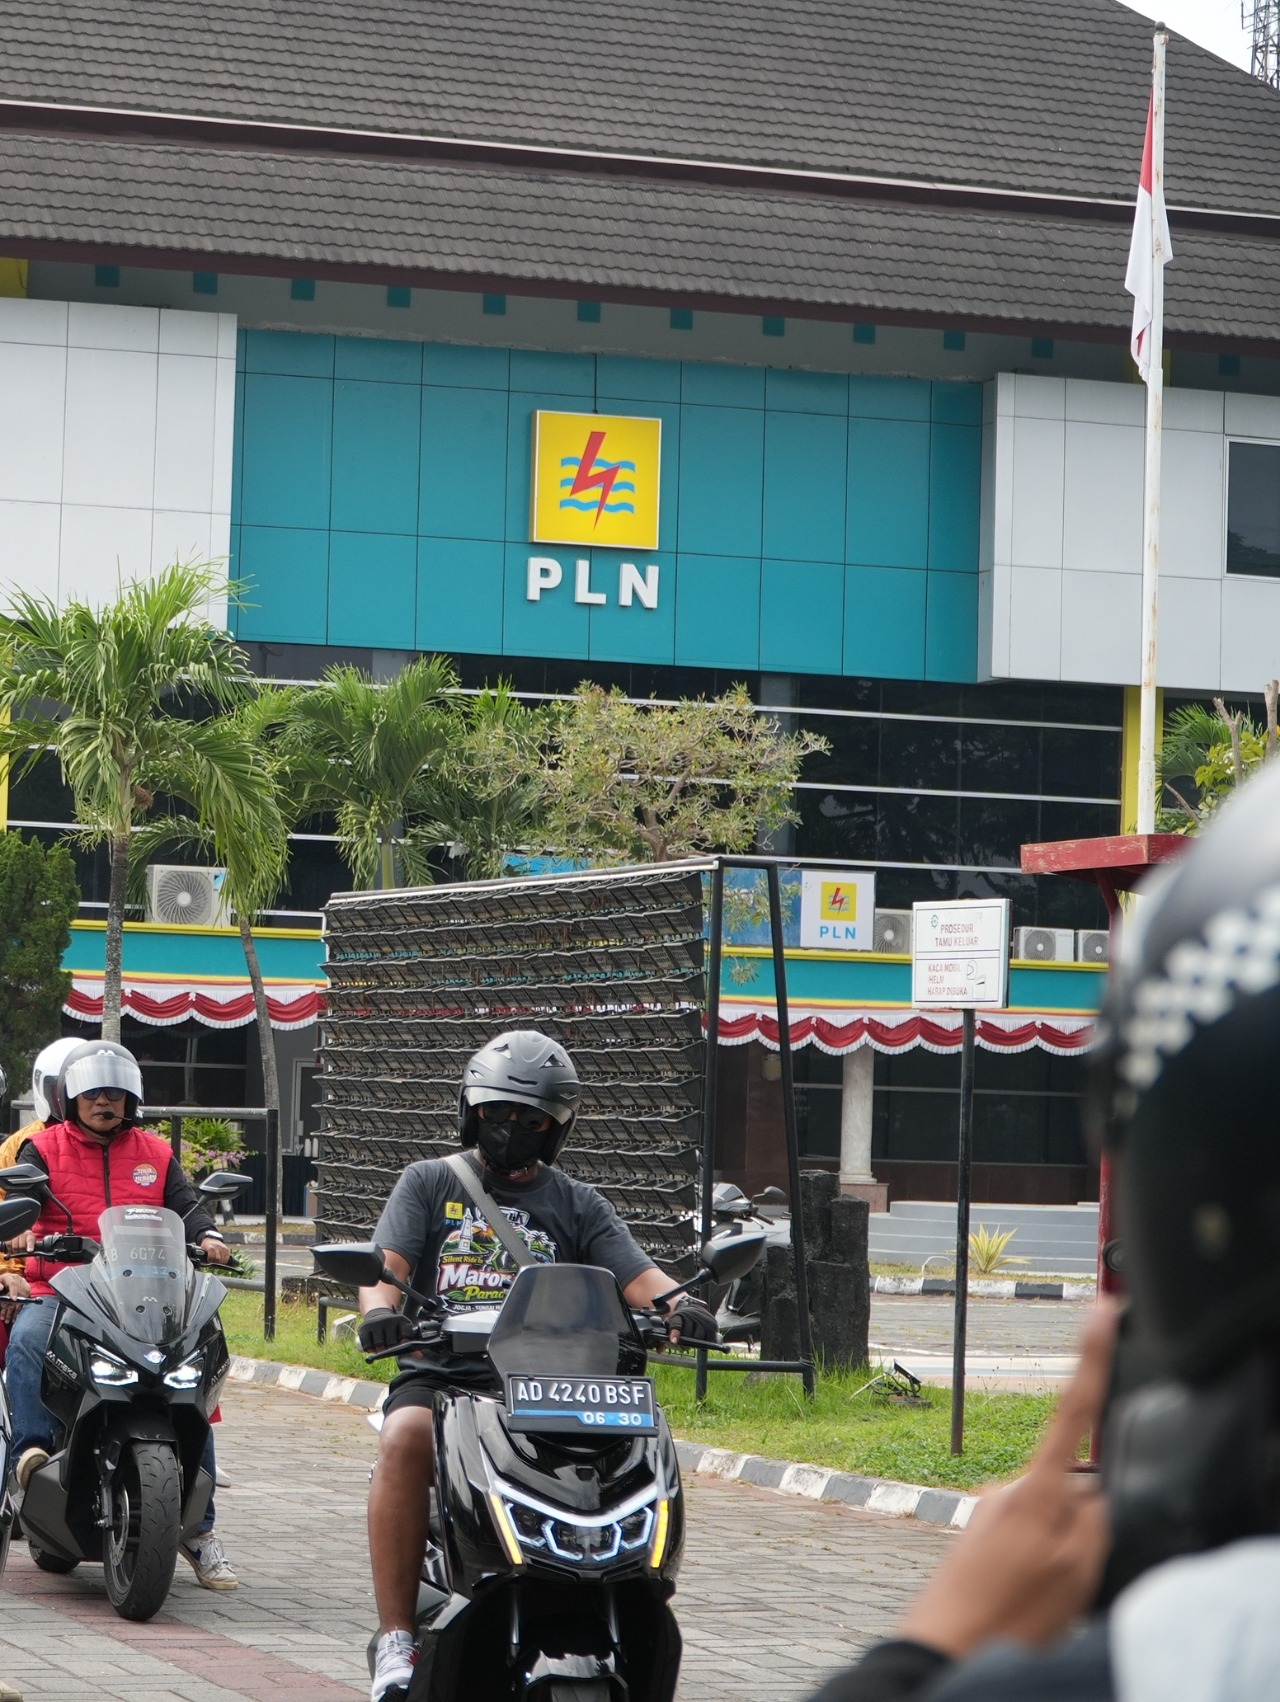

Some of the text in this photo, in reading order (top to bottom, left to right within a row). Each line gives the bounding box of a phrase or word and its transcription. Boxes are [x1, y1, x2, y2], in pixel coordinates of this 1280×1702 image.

[527, 557, 659, 609] PLN
[820, 925, 856, 940] PLN
[941, 924, 973, 934] PROSEDUR
[935, 937, 978, 947] TAMU KELUAR
[928, 964, 943, 972] KACA
[929, 976, 944, 984] HELM
[928, 987, 968, 996] HARAP DIBUKA
[442, 1256, 463, 1264] Silent
[463, 1256, 477, 1264] Ride
[517, 1382, 645, 1405] AD 4240 BSF
[583, 1411, 642, 1426] 06 30
